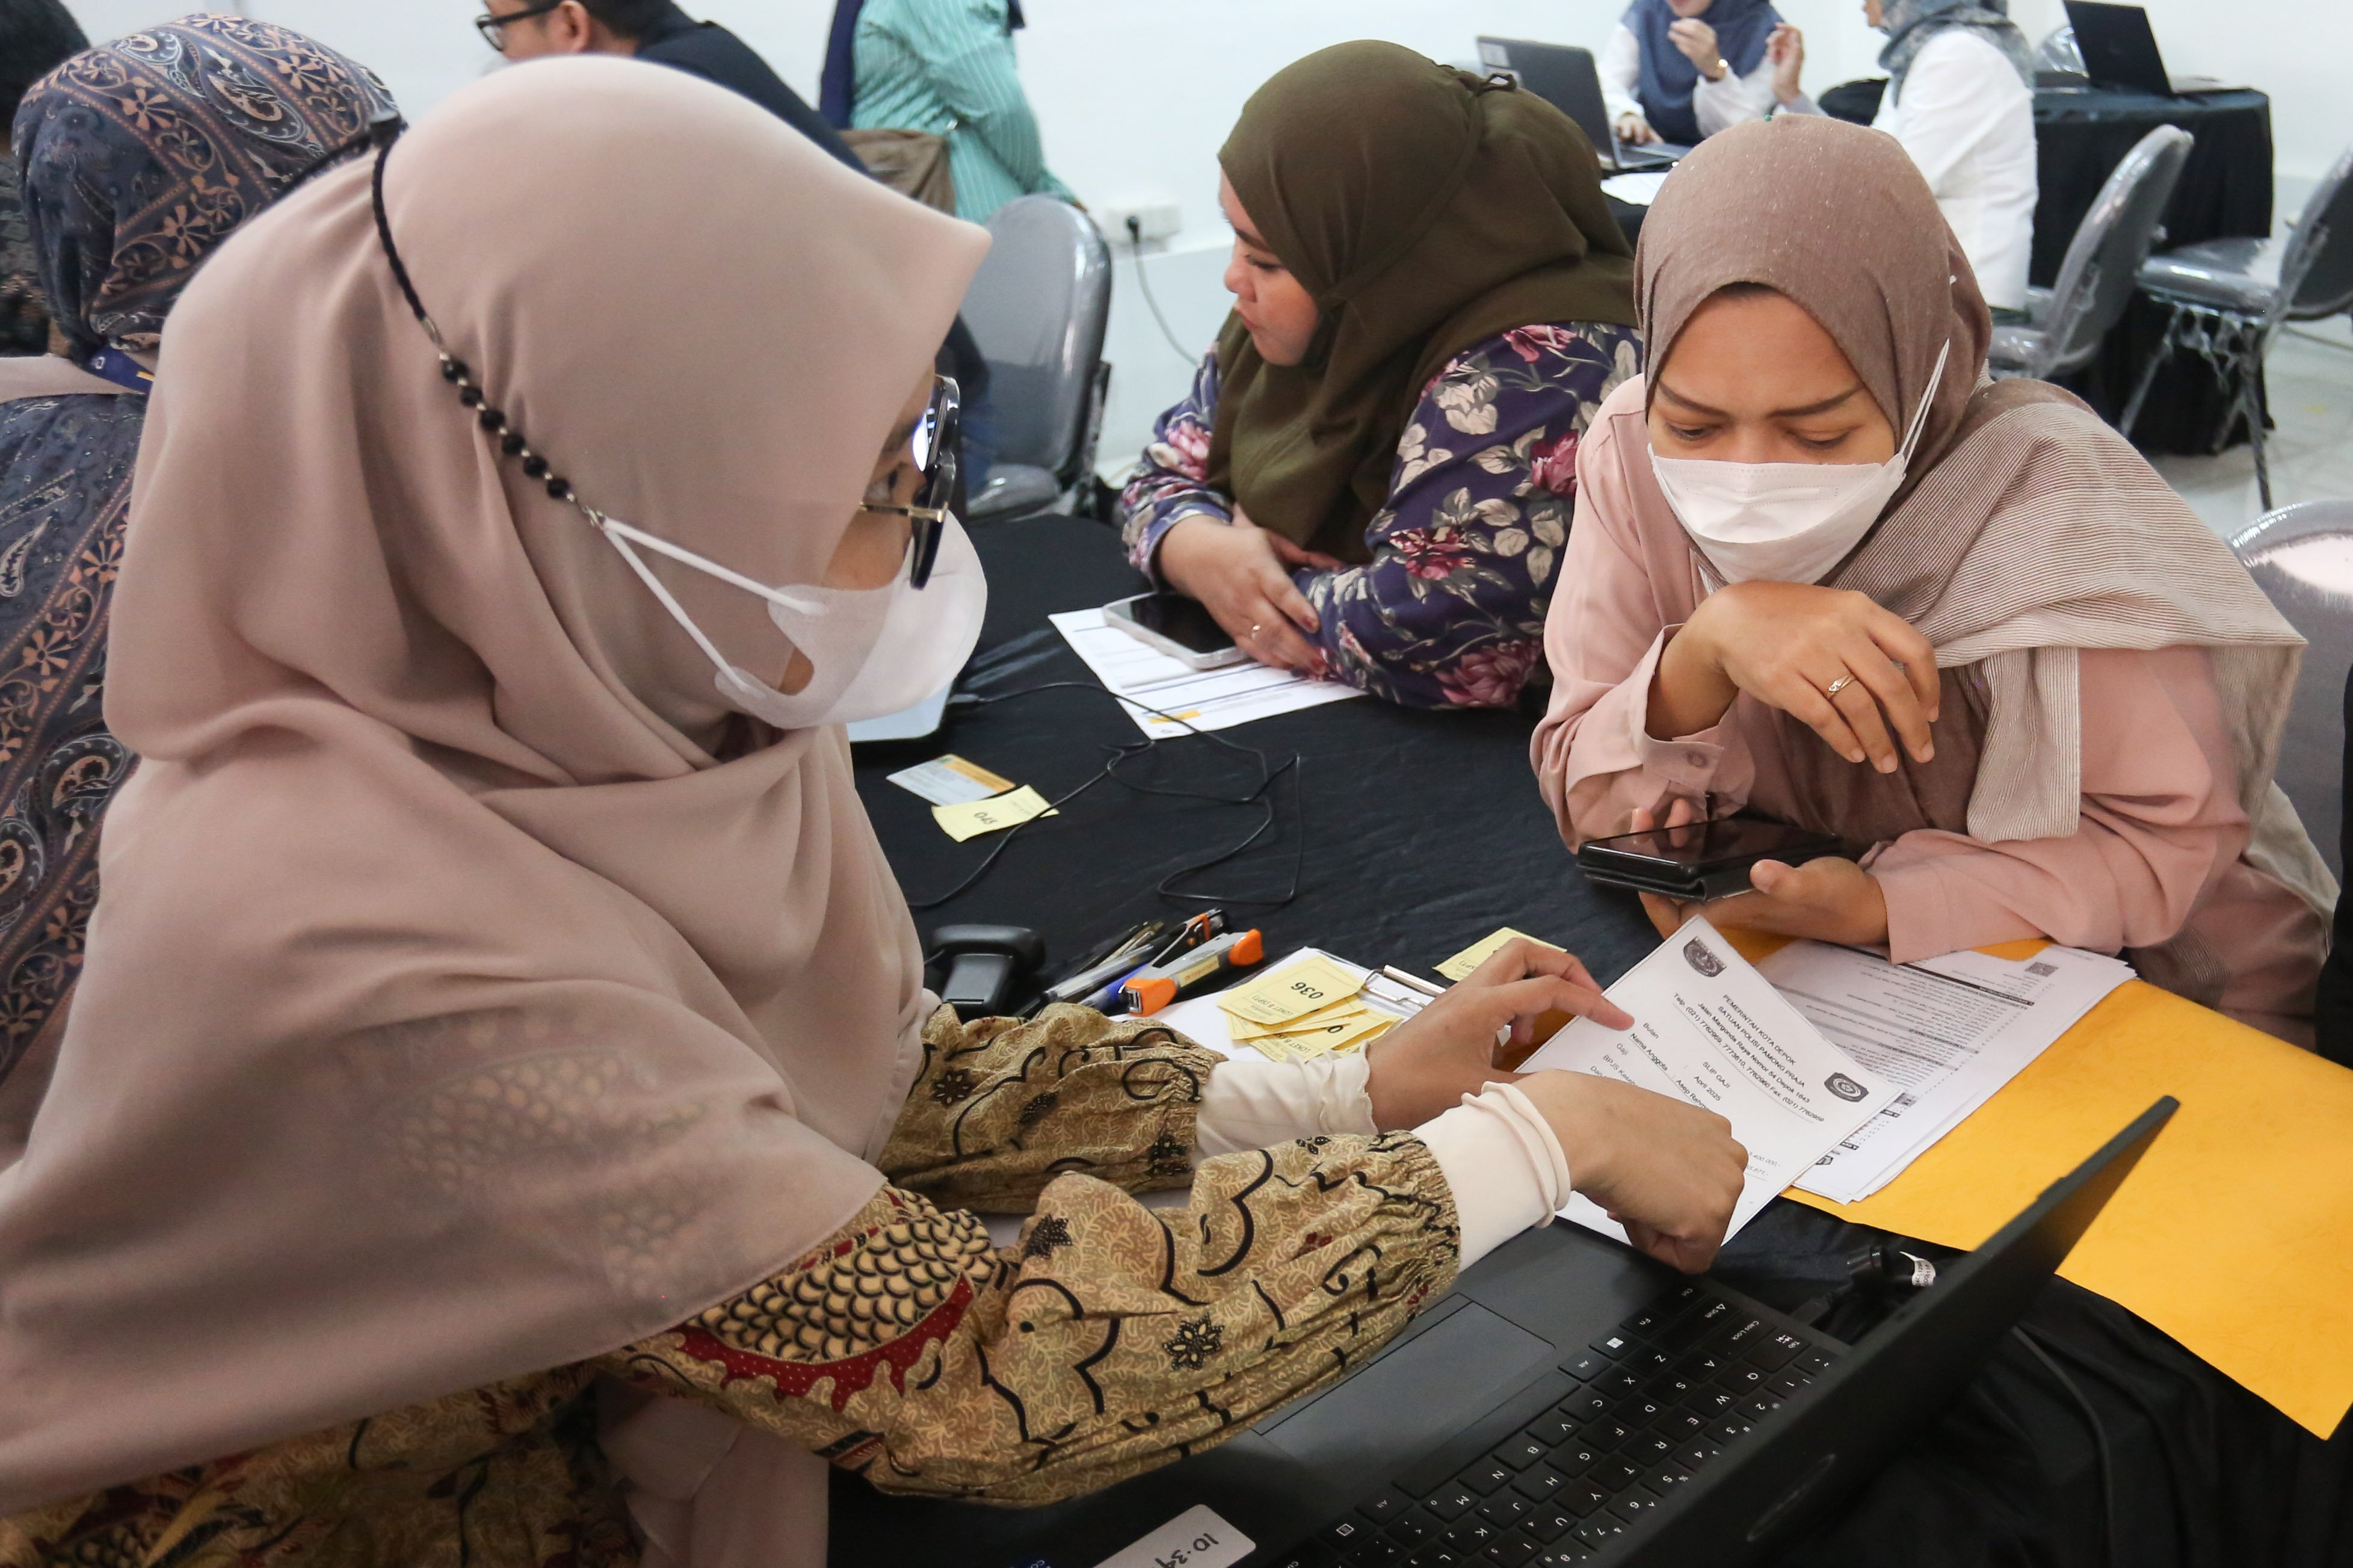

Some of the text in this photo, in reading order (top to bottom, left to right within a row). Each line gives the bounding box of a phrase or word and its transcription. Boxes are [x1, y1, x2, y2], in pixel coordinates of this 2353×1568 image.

[1290, 982, 1324, 1000] 036
[1722, 994, 1796, 1066] PEMERINTAH KOTA DEPOK
[1616, 1043, 1629, 1057] Gaji
[1698, 1002, 1713, 1017] Jalan
[1712, 1016, 1737, 1043] Margonda
[1737, 1042, 1751, 1056] Raya
[1750, 1054, 1769, 1073] Nomor
[1776, 1077, 1795, 1094] Depok
[1718, 1006, 1806, 1088] SATUAN POLISI PAMONG PRAJA
[1603, 1055, 1620, 1071] BPJS
[1630, 1033, 1647, 1050] Nama
[1646, 1049, 1668, 1072] Anggota
[1676, 1079, 1691, 1094] Asep
[1642, 1022, 1721, 1102] Bulan April 2025
[1686, 1007, 1701, 1022] (021)
[1782, 1097, 1799, 1109] (021)
[1702, 1061, 1731, 1088] SLIP GAJI
[1623, 1377, 1635, 1385] X
[1716, 1395, 1730, 1405] W
[1687, 1417, 1699, 1425] E
[1527, 1446, 1539, 1454] B
[1491, 1470, 1505, 1480] N
[1545, 1477, 1558, 1486] H
[1456, 1495, 1470, 1505] M
[1555, 1517, 1568, 1526] U
[1475, 1528, 1488, 1537] K
